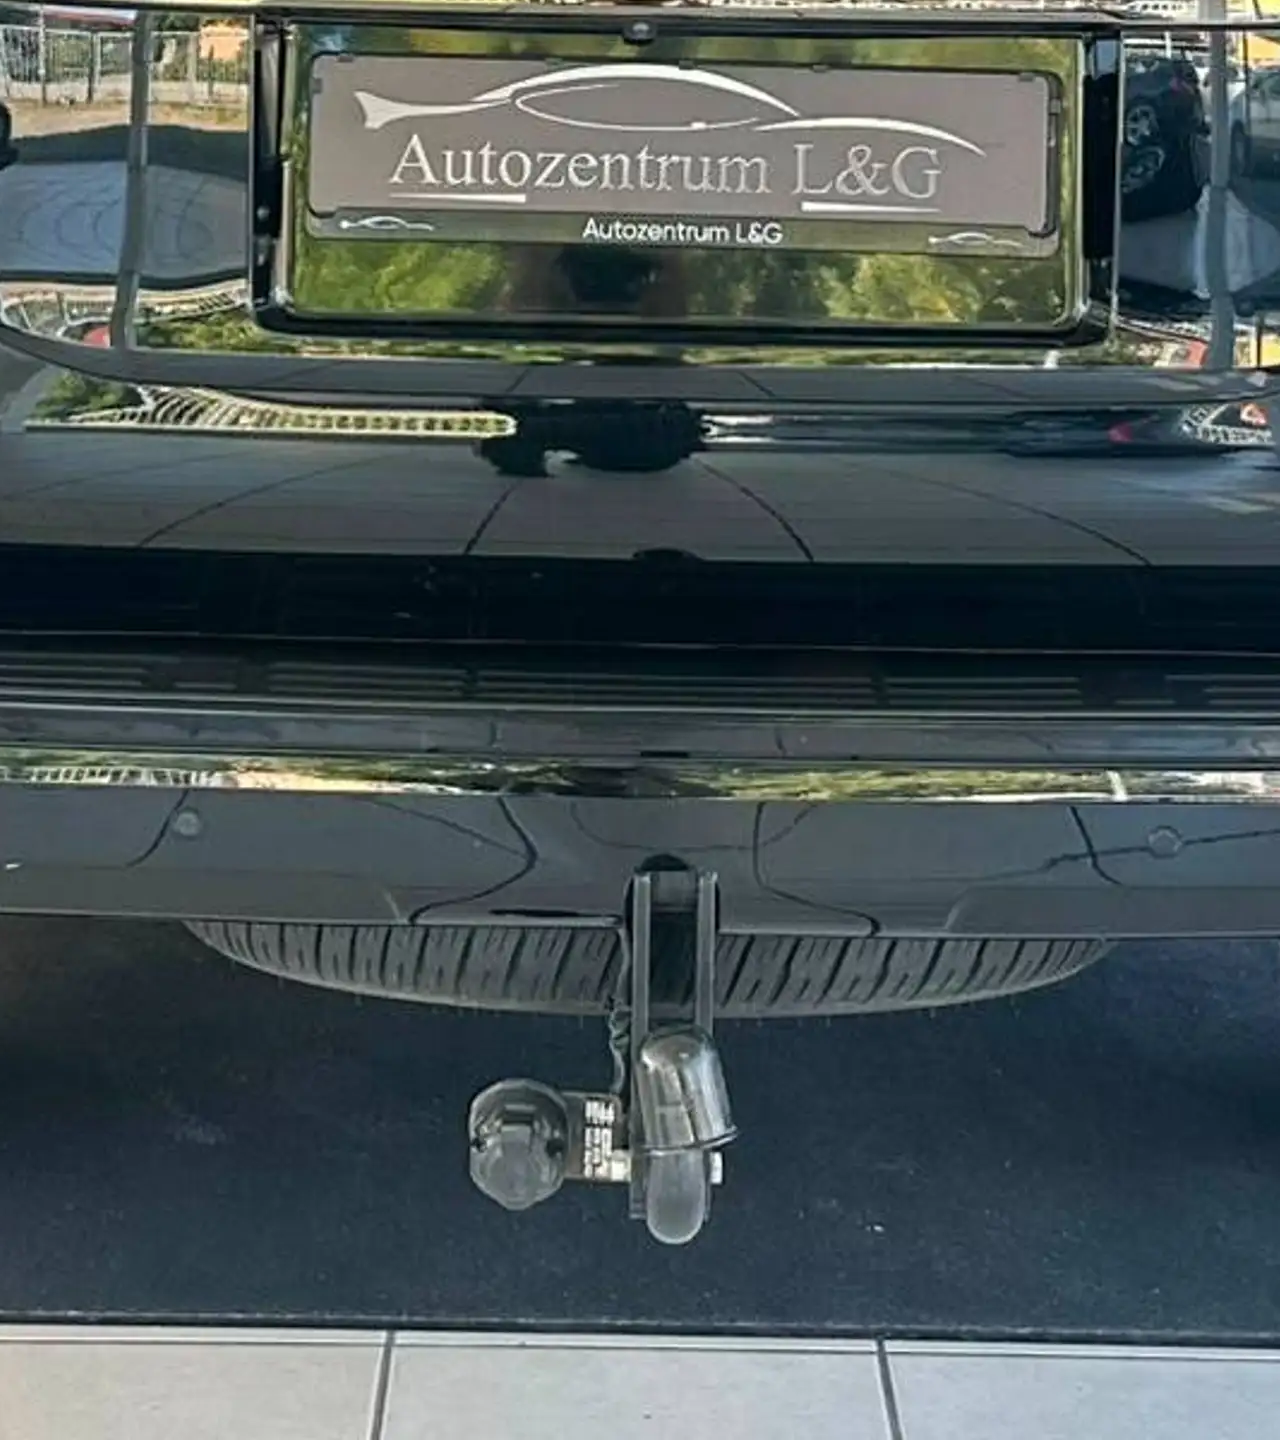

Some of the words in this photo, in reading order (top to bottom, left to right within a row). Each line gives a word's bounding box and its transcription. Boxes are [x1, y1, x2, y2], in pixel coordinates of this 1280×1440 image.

[389, 133, 768, 196] Autozentrum
[792, 143, 941, 201] L&G
[582, 218, 731, 244] Autozentrum
[734, 220, 783, 246] L&G
